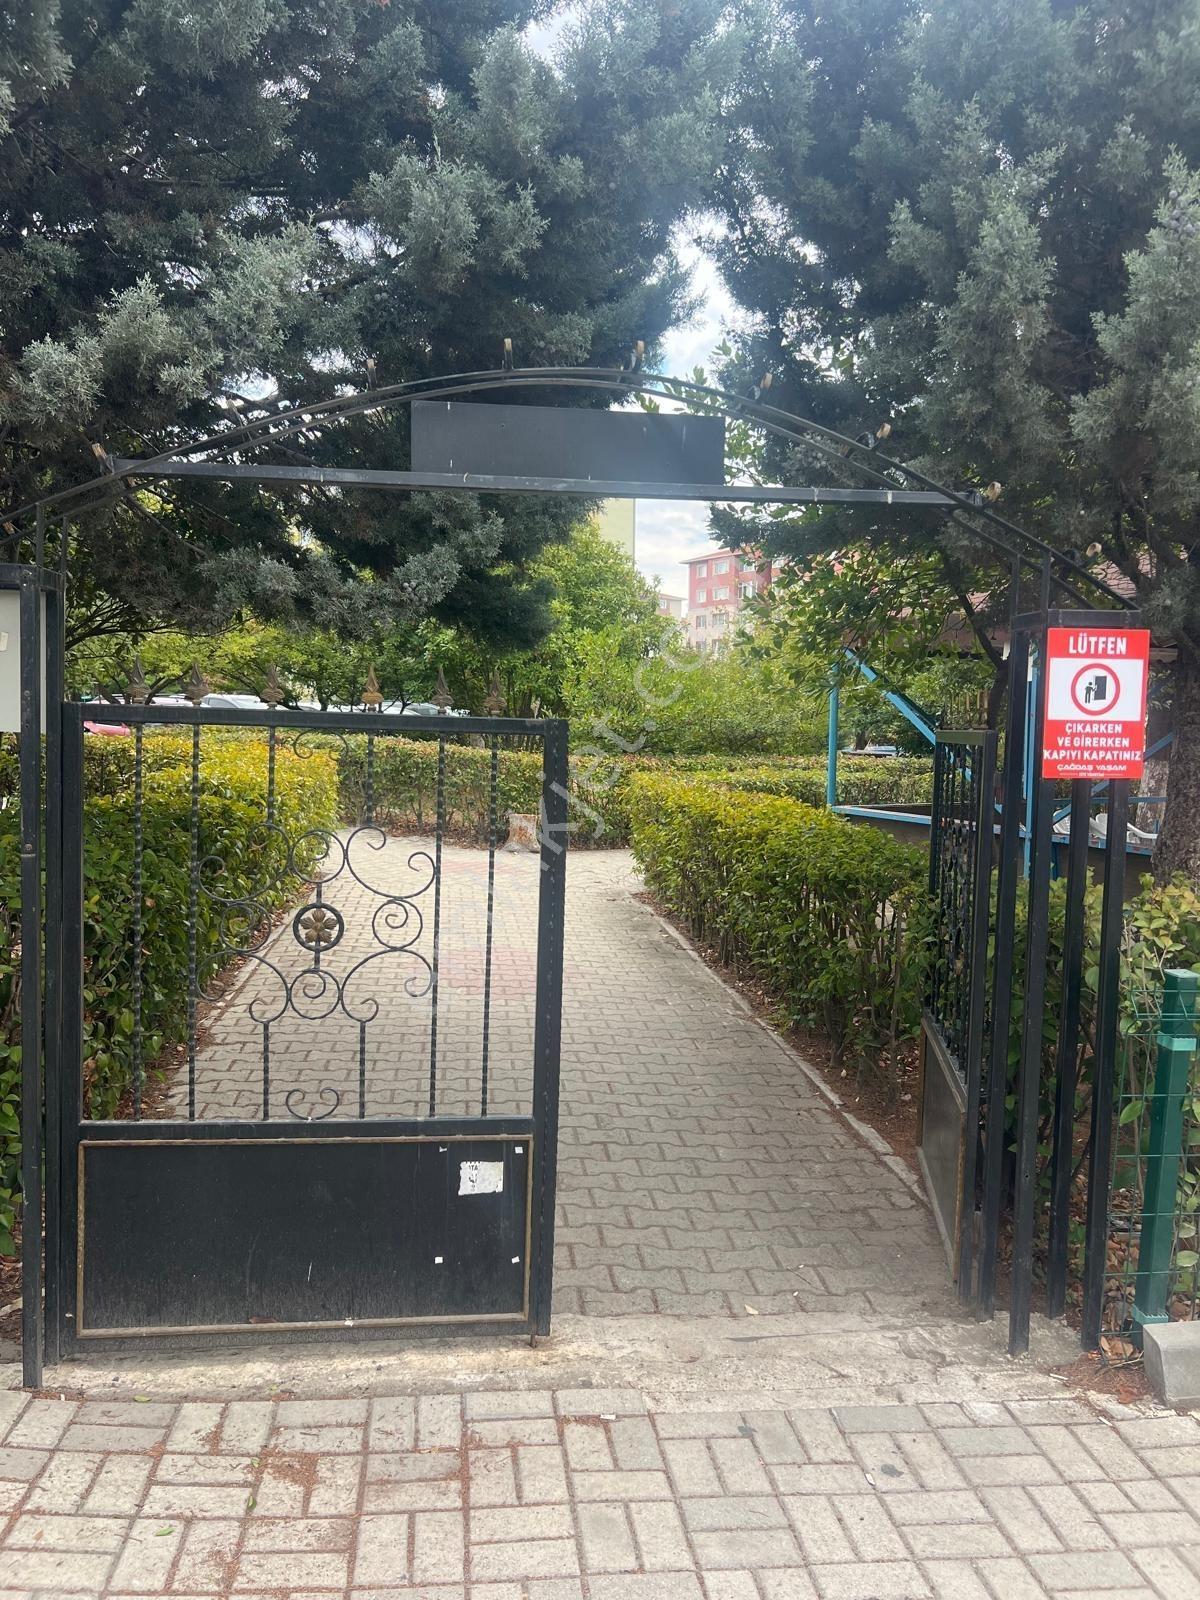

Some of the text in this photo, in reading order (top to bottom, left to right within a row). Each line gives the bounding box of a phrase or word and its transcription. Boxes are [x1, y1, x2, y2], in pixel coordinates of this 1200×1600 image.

[1068, 632, 1127, 655] LÜTFEN
[1065, 723, 1123, 735] ÇIKARKEN
[1057, 734, 1130, 748] VE GİRERKEN
[1043, 749, 1142, 761] KAPIYI KAPATINIZ
